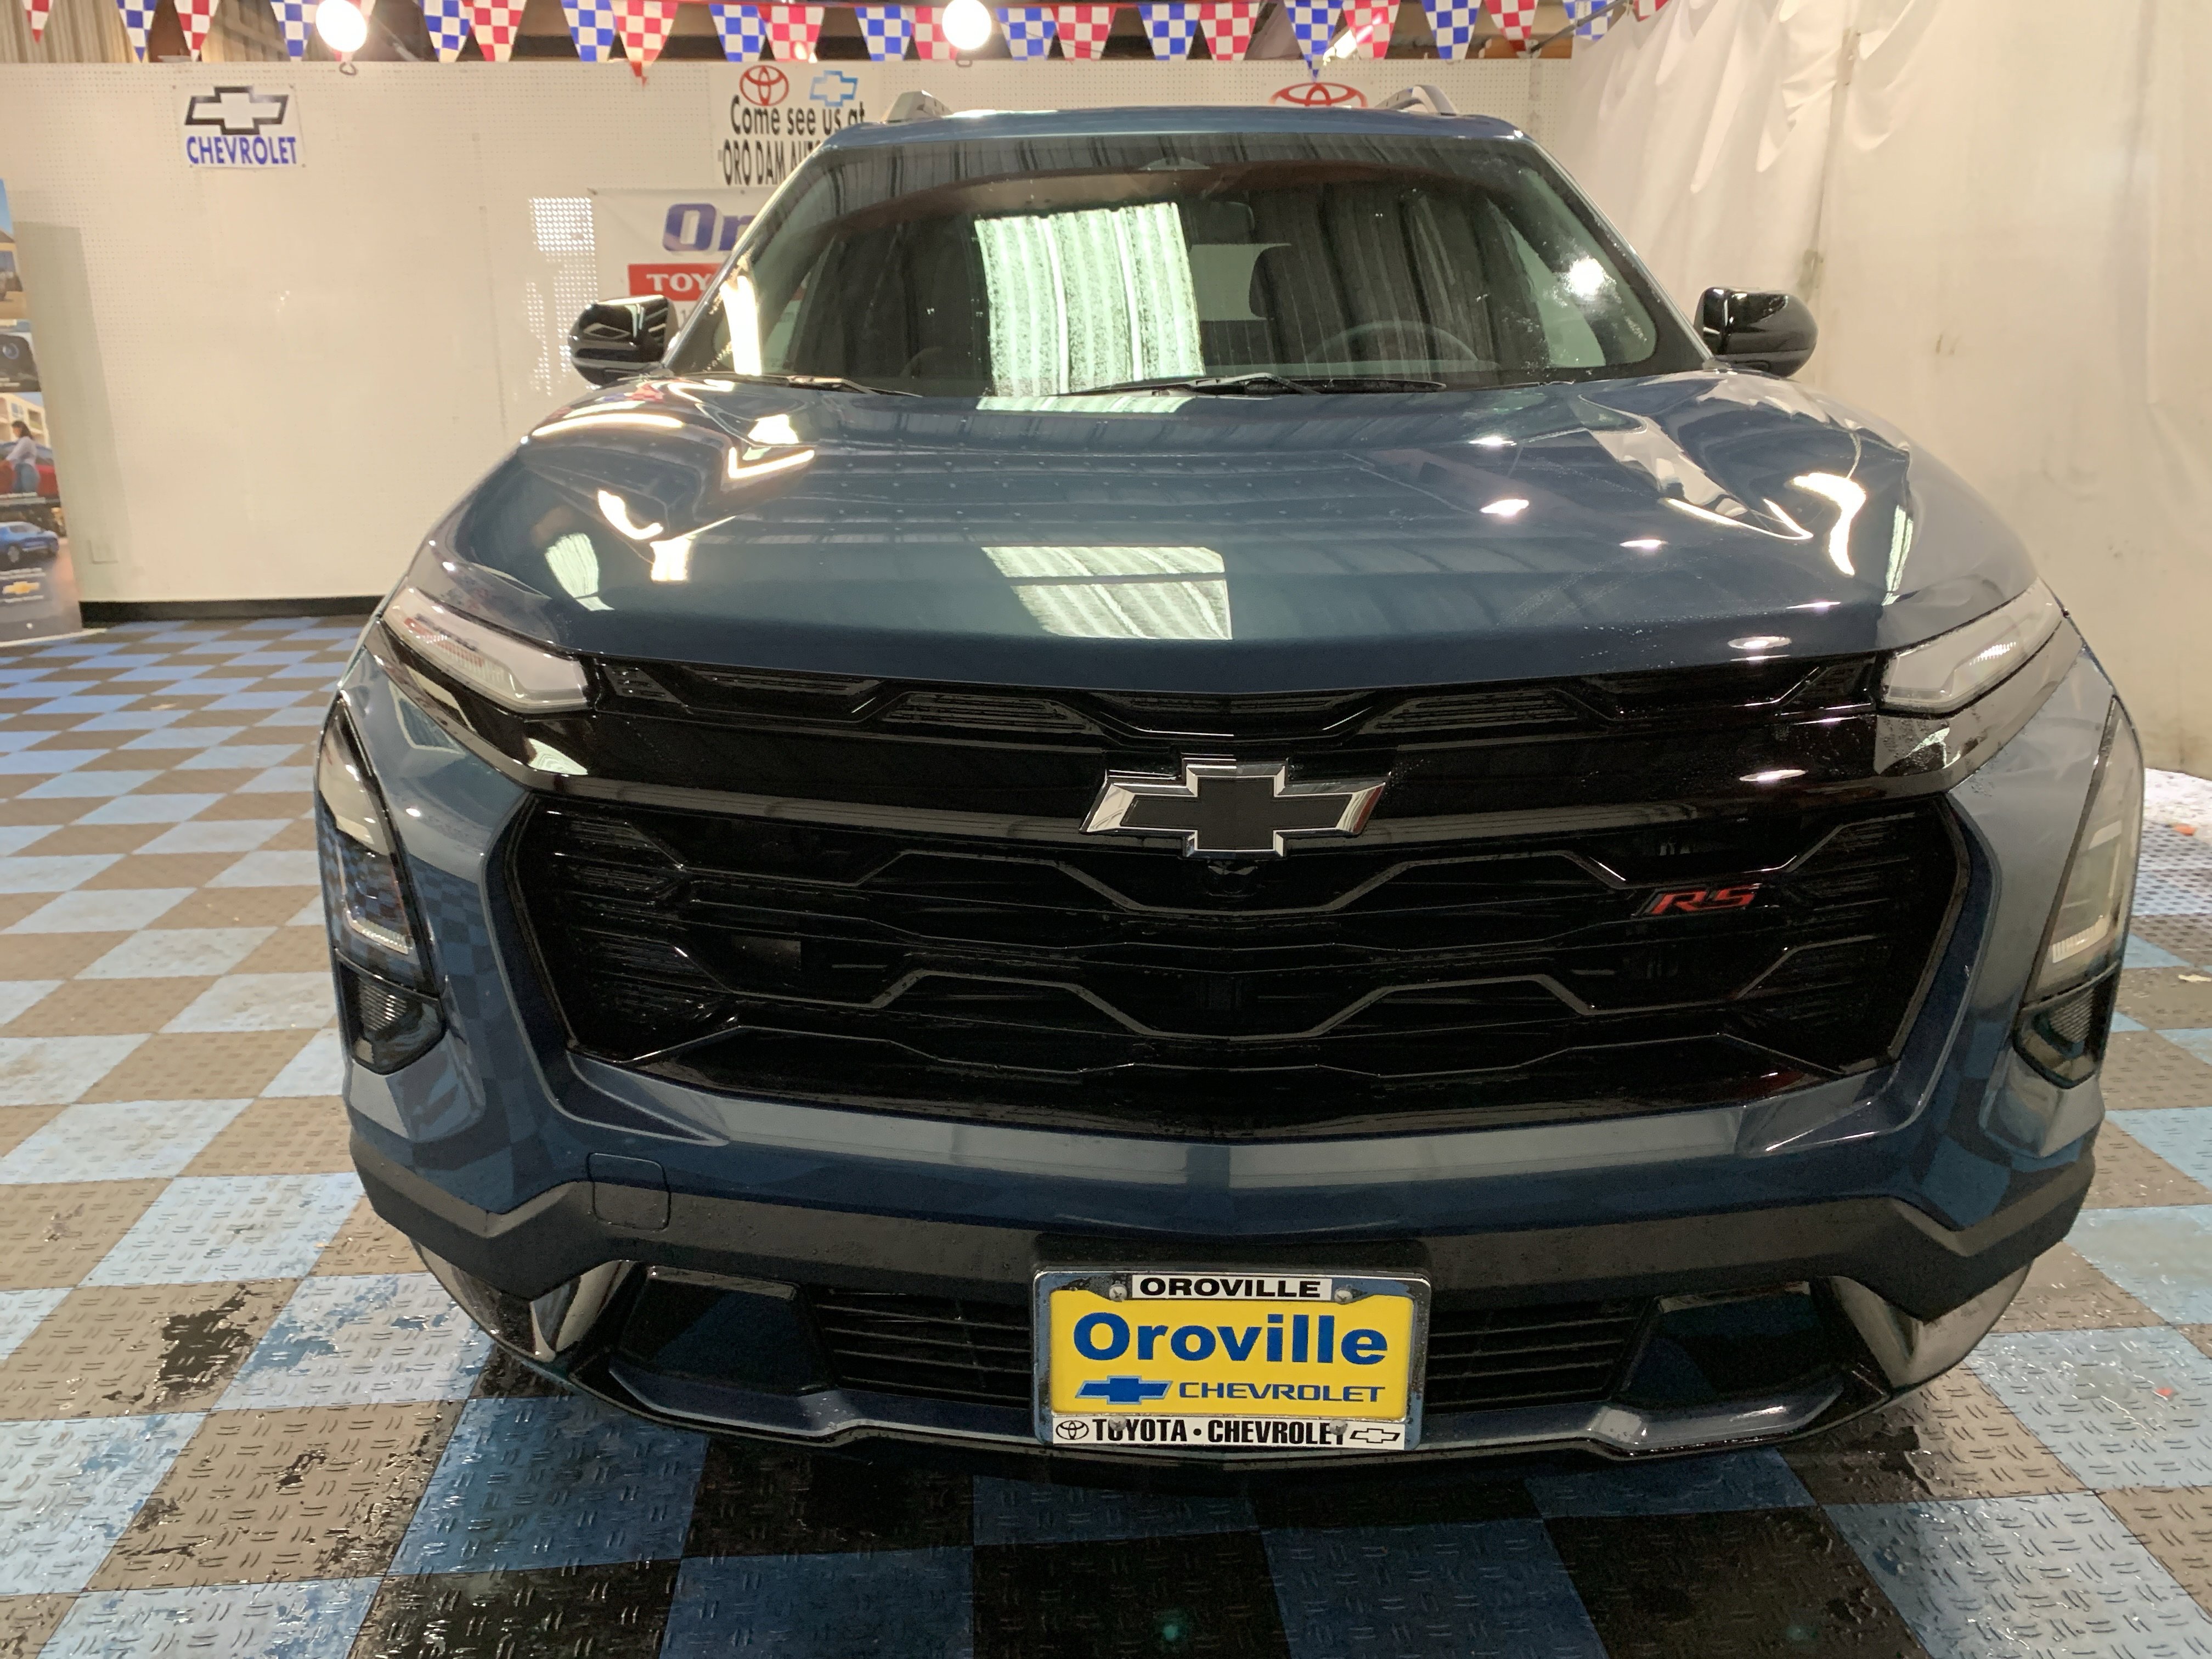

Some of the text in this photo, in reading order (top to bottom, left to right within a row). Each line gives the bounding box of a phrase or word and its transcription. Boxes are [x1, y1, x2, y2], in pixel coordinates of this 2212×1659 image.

[730, 95, 780, 135] Come
[787, 107, 816, 136] see
[822, 108, 842, 136] us
[187, 135, 297, 165] CHEVROLET
[723, 139, 752, 186] ORO
[755, 140, 786, 185] DAM
[1641, 883, 1762, 916] RS
[1139, 1277, 1321, 1298] OROVILLE
[1073, 1312, 1388, 1365] Oroville
[1179, 1381, 1386, 1402] CHEVROLET
[1092, 1418, 1188, 1442] TOYOTA
